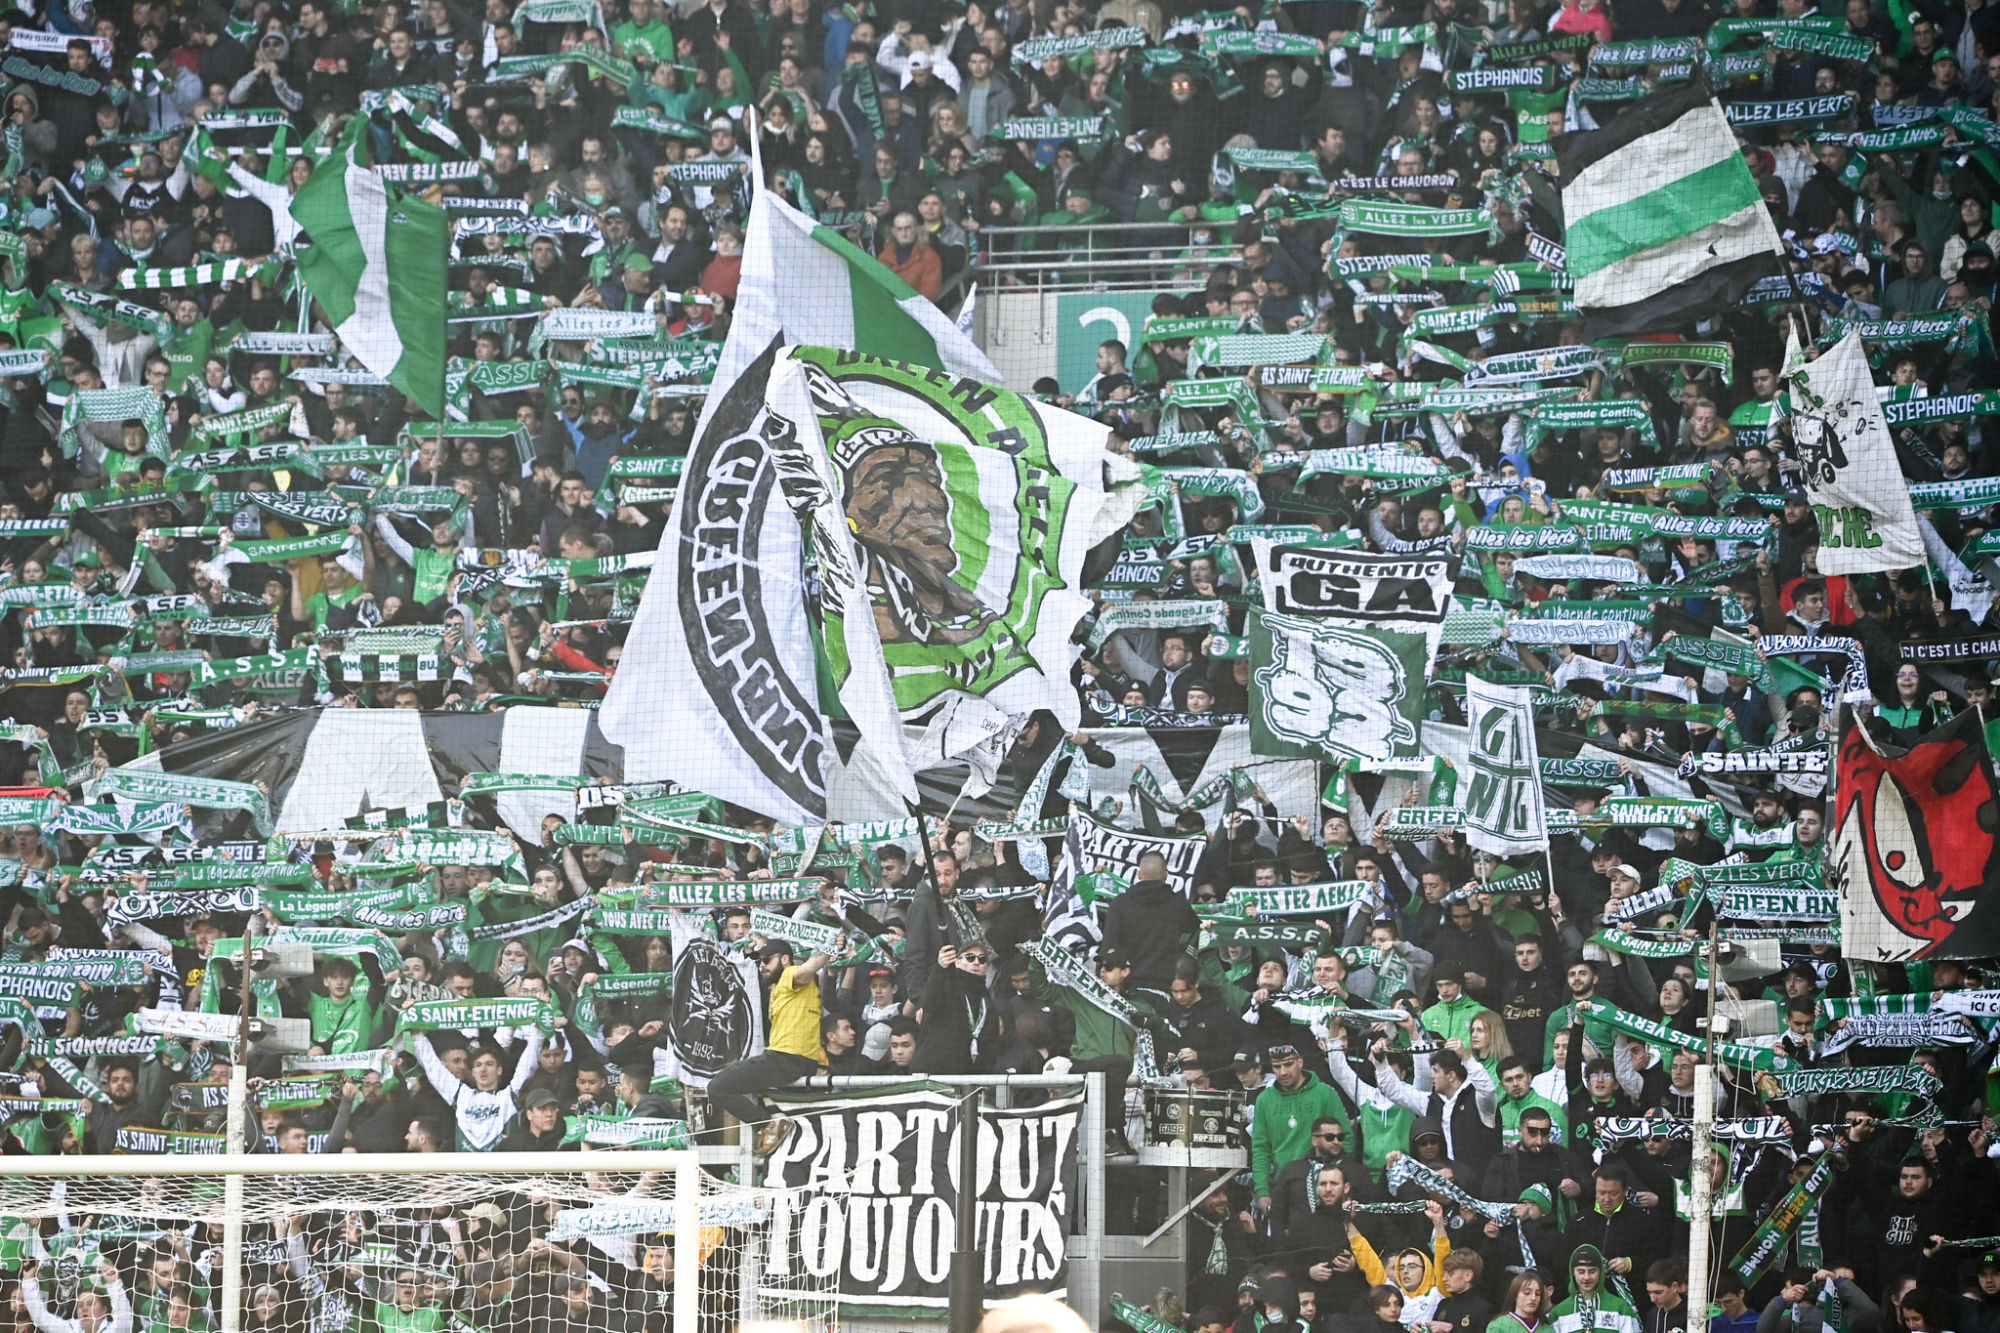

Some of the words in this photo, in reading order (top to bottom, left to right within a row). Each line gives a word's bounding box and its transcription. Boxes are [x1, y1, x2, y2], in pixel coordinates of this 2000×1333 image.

[1553, 33, 1591, 51] VERTS
[1594, 45, 1620, 65] llez
[1623, 45, 1648, 62] les
[1650, 42, 1689, 60] Verts
[1725, 104, 1773, 122] ALLEZ
[1776, 101, 1805, 119] LES
[1808, 95, 1855, 115] VERTS
[1003, 116, 1102, 138] INT-ETIENNE
[670, 162, 740, 182] STÉPHANO
[1376, 176, 1389, 188] LE
[1391, 174, 1455, 188] CHAUDRON
[1365, 212, 1409, 225] ALLEZ
[1431, 211, 1473, 224] VERTS
[1529, 236, 1566, 268] ALLEZ
[1490, 302, 1517, 314] LUB
[628, 314, 656, 330] Ver
[1841, 321, 1881, 337] Allez
[1884, 320, 1907, 336] les
[1910, 319, 1952, 335] Verts
[0, 352, 41, 367] NGELS
[1486, 358, 1537, 376] GREEN
[1262, 368, 1275, 386] AS
[342, 449, 369, 461] LES
[626, 456, 685, 473] SAINT-ET
[1610, 469, 1624, 486] AS
[1626, 462, 1711, 484] SAINT-ETIENNE
[303, 504, 349, 522] VERTS
[1561, 503, 1652, 526] SAINT-ETIEN
[1467, 526, 1507, 548] Allez
[1509, 526, 1535, 546] les
[1537, 524, 1580, 546] Verts
[1652, 517, 1696, 533] Allez
[1697, 517, 1722, 535] les
[1725, 517, 1768, 535] Verts
[248, 533, 342, 558] SAINT-ETIENNE
[1104, 565, 1162, 583] HANOIS
[1289, 557, 1441, 577] AUTHENTIC
[1291, 573, 1439, 612] GA
[1674, 636, 1742, 665] ASSE
[1917, 642, 1952, 658] C'EST
[1955, 642, 1968, 656] LE
[254, 669, 306, 690] ALLEZ
[1543, 757, 1623, 778] ASSE
[1399, 809, 1467, 826] GREEN
[1730, 867, 1761, 881] LES
[1766, 862, 1817, 881] VERTS
[668, 883, 715, 904] ALLEZ
[719, 882, 747, 902] LES
[752, 879, 799, 900] VERTS
[1619, 884, 1672, 918] REEN
[297, 899, 342, 913] Légend
[353, 906, 396, 927] Allez
[399, 913, 426, 928] les
[41, 962, 70, 979] les
[71, 961, 115, 981] Allez
[1040, 935, 1110, 999] GREEN
[0, 977, 76, 1001] PHANOIS
[400, 1006, 420, 1024] AS
[423, 1001, 538, 1023] SAINT-ETIENNE
[1613, 1008, 1665, 1038] VERTS
[1666, 1026, 1703, 1049] LES
[203, 1087, 219, 1108] AS
[117, 1129, 129, 1148] AS
[131, 1132, 227, 1154] SAINT-ETIENNE
[1739, 1229, 1781, 1279] HOMME
